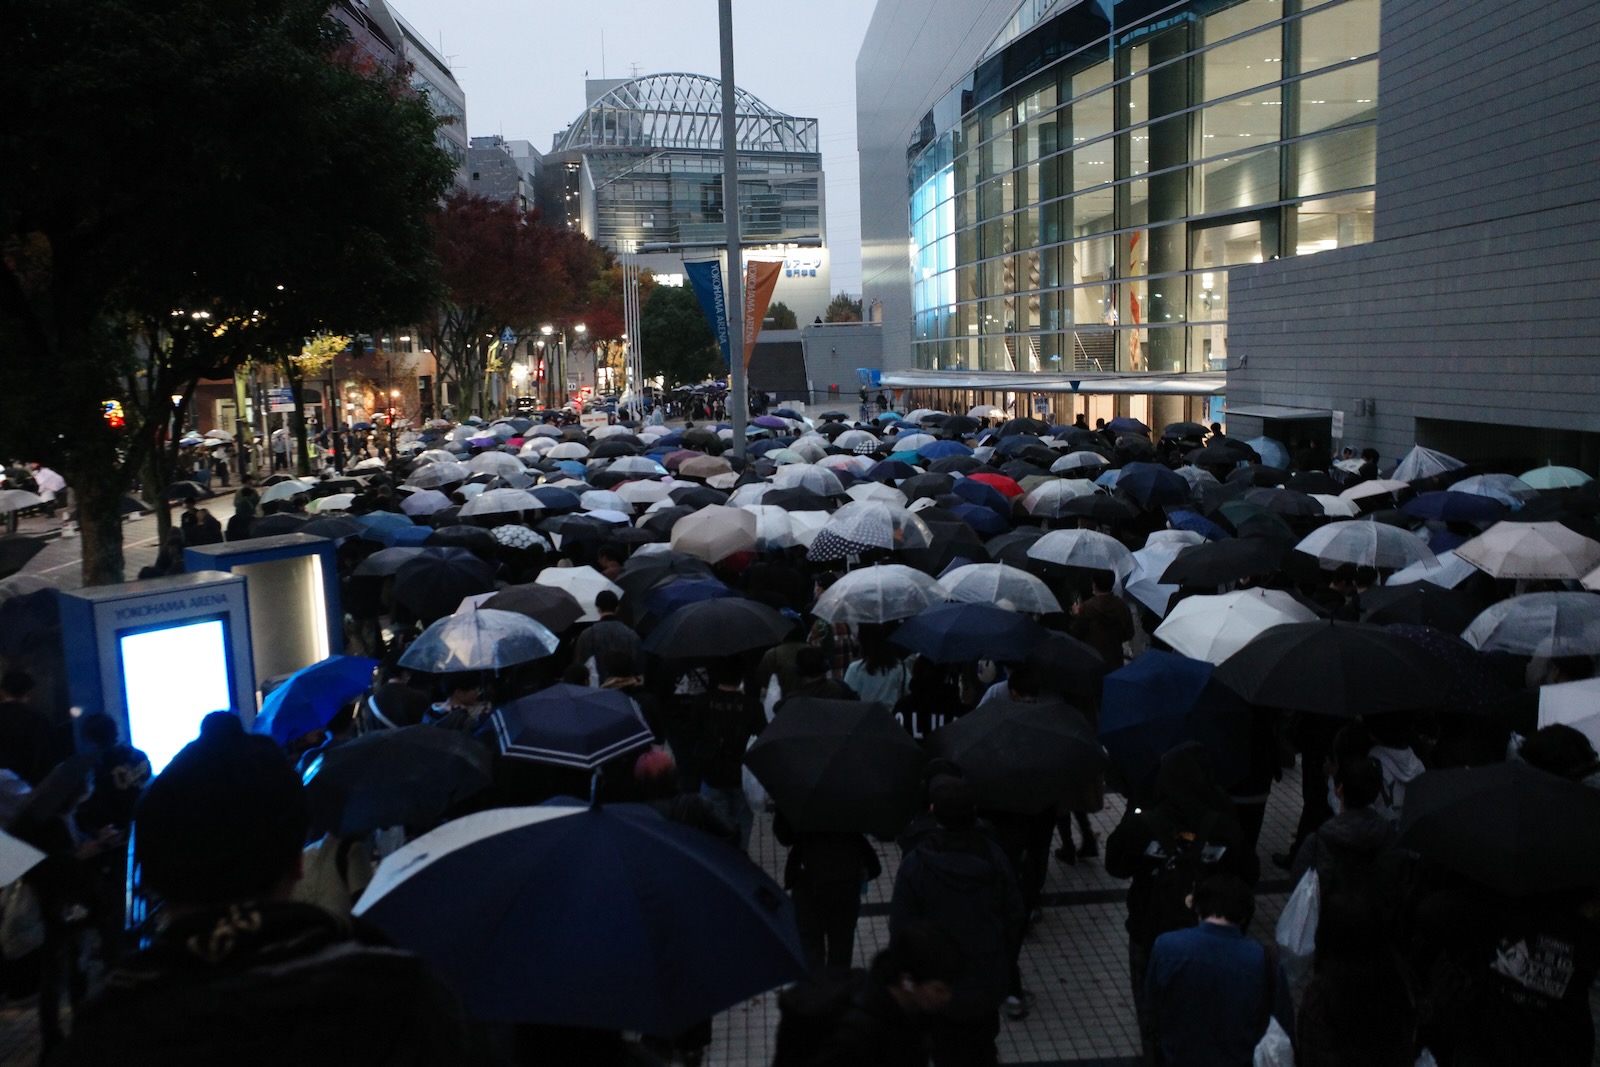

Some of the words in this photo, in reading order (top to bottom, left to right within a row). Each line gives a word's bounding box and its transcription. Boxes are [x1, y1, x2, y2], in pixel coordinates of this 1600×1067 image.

[711, 264, 723, 313] YOKOHAMA
[746, 263, 758, 313] YOKOHAMA
[716, 315, 728, 345] ARENA
[745, 315, 755, 344] ARENA
[116, 600, 186, 619] YOKOHAMA
[191, 594, 227, 607] ARENA
